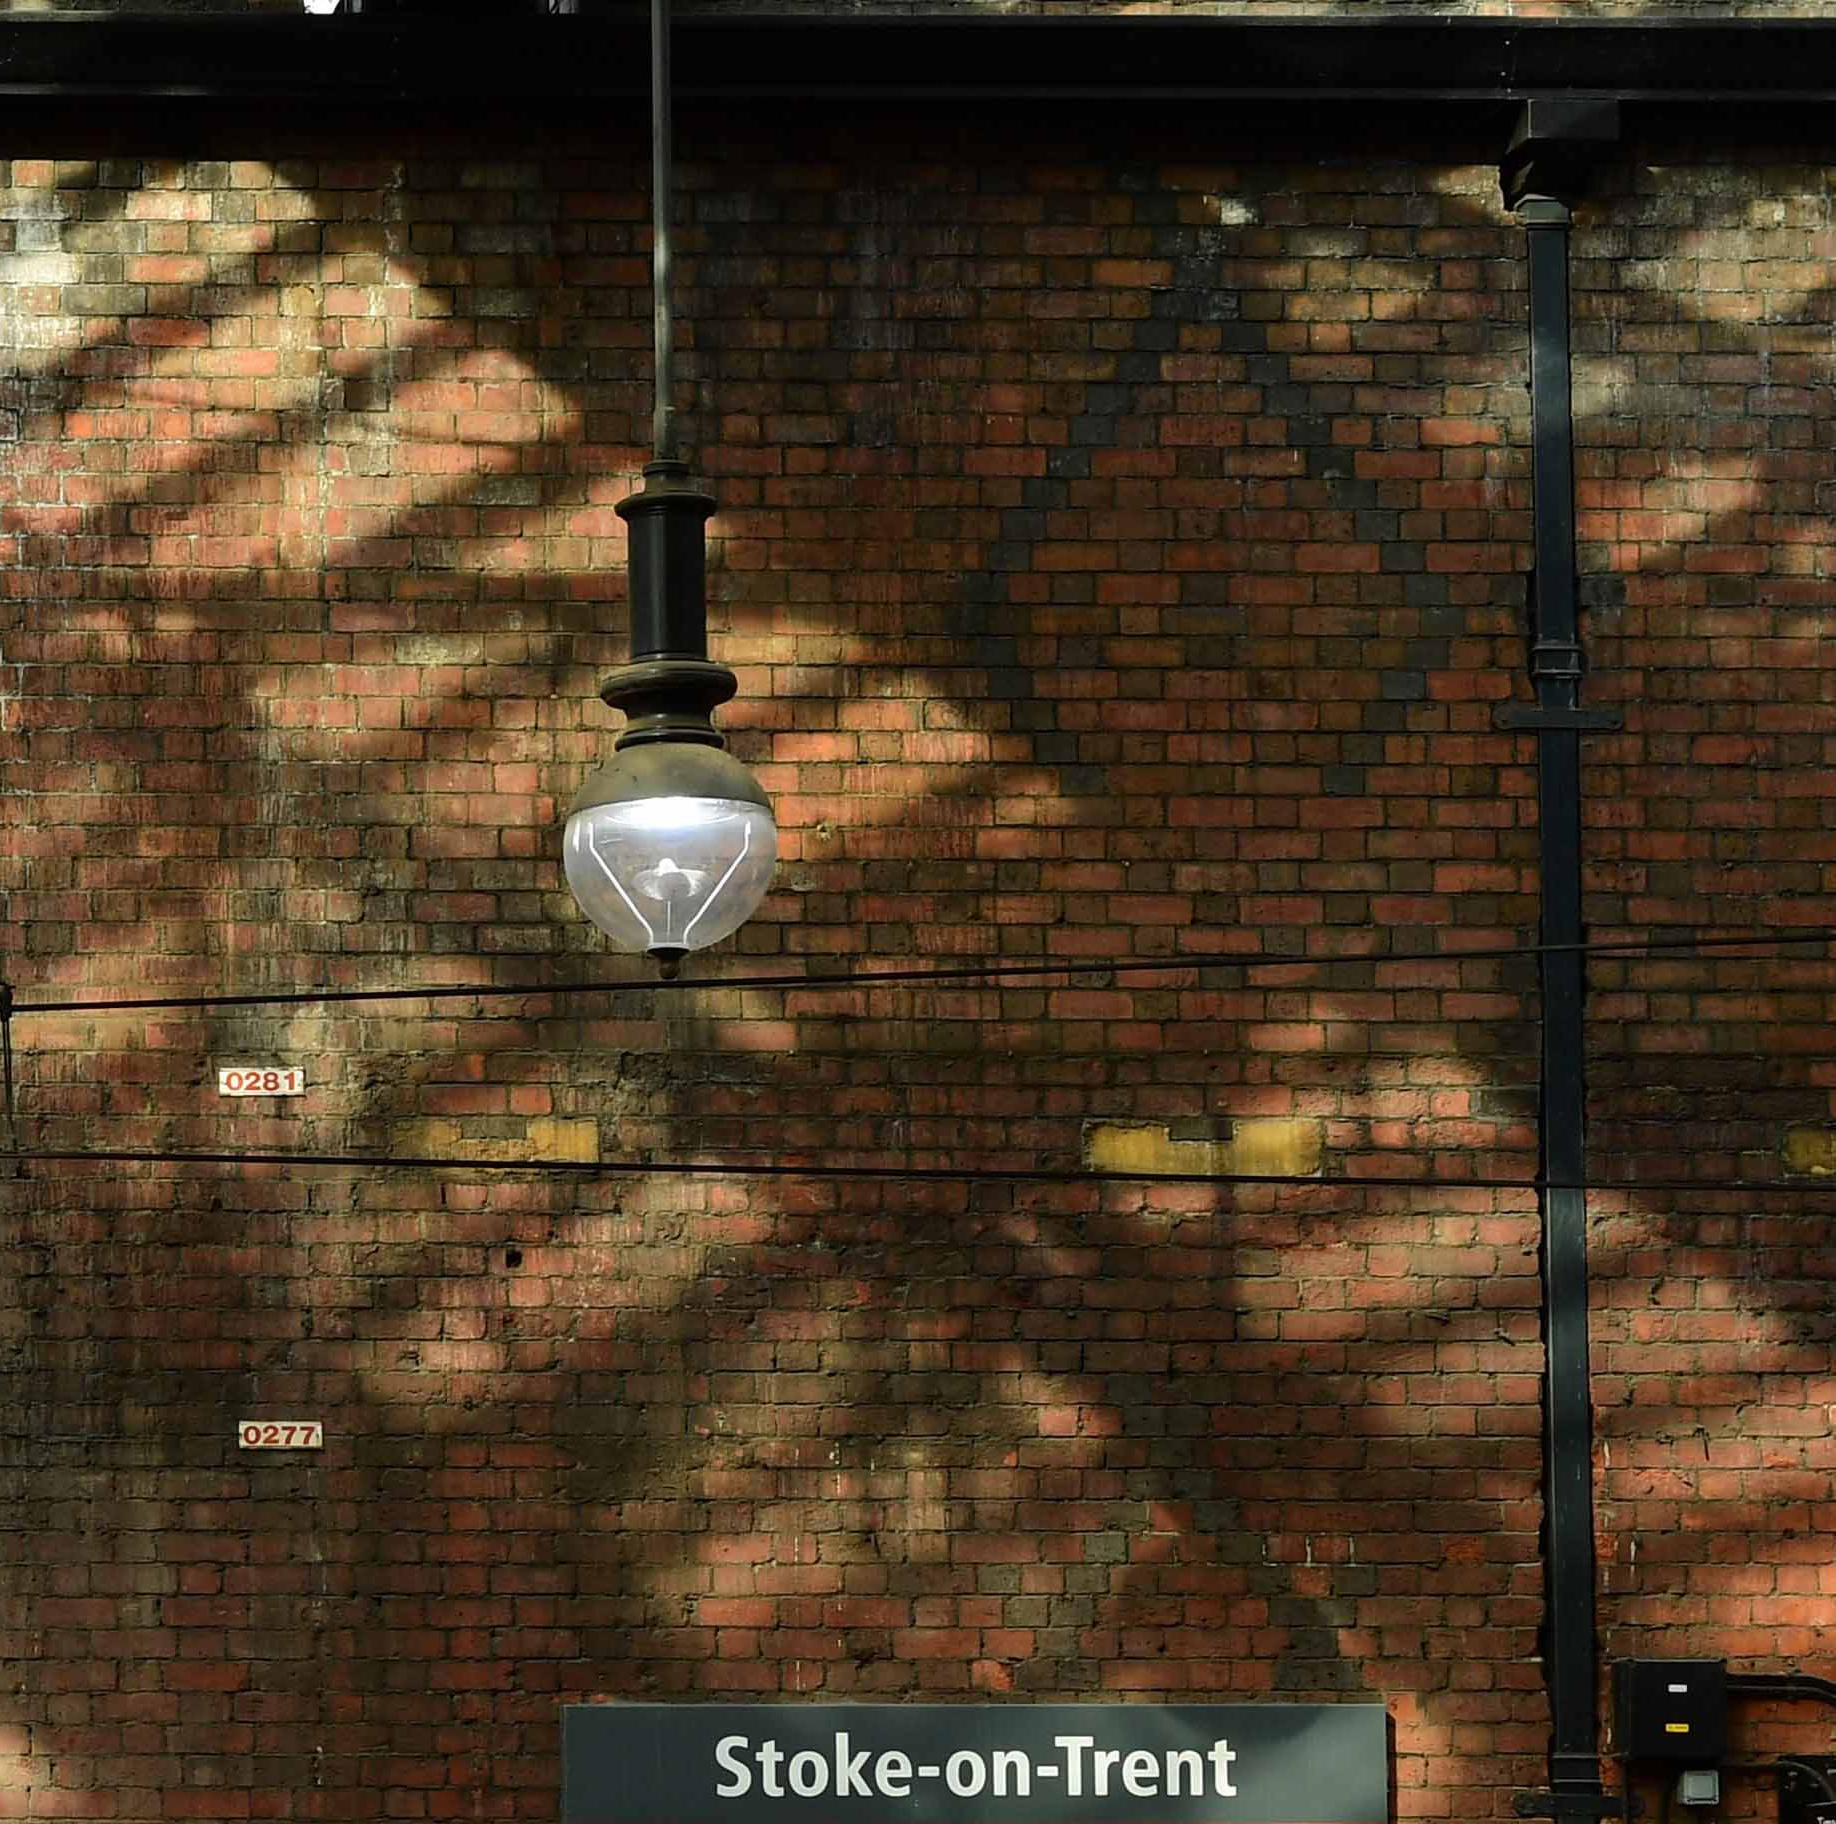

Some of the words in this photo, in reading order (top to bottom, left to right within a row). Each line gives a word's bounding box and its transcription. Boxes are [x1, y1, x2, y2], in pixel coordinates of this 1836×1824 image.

[226, 1072, 295, 1090] 0281
[243, 1425, 315, 1444] 0277
[714, 1731, 1238, 1798] Stoke-on-Trent
